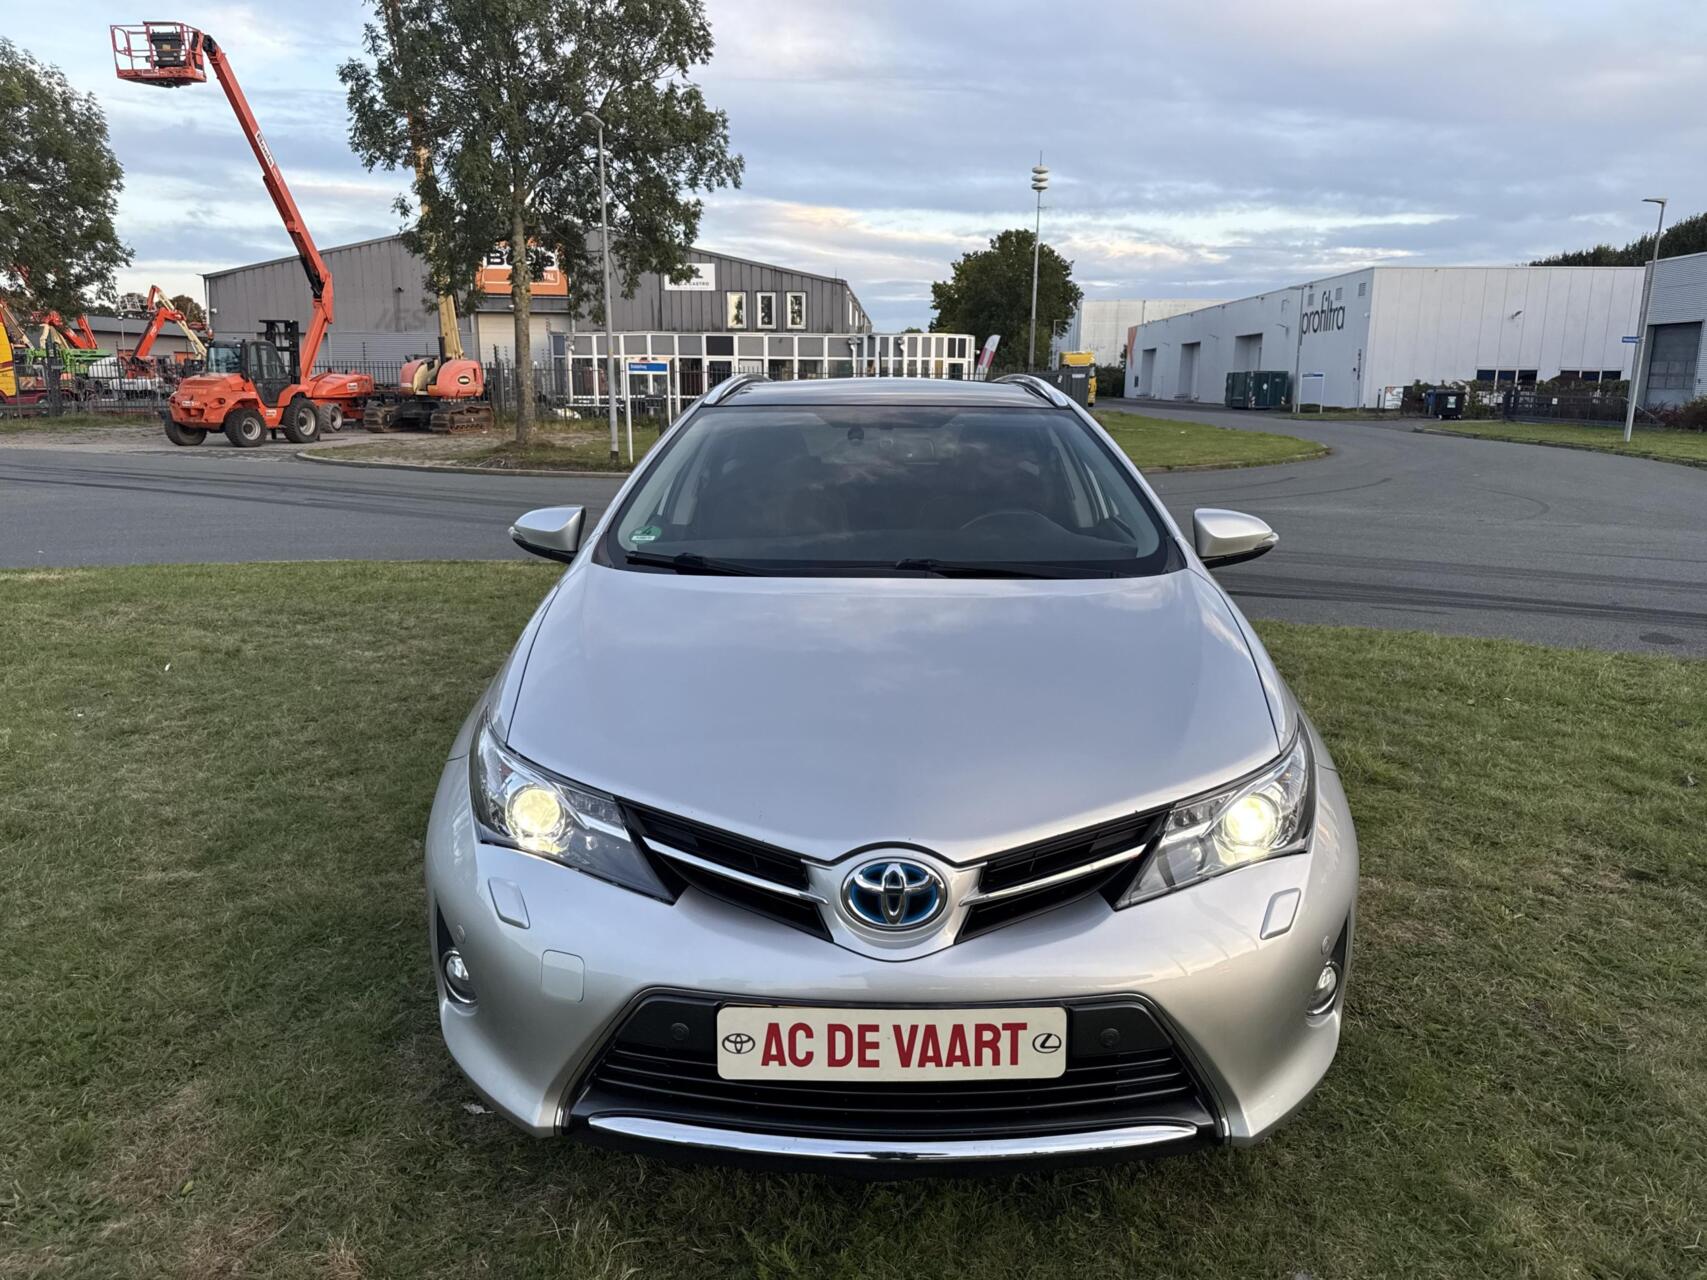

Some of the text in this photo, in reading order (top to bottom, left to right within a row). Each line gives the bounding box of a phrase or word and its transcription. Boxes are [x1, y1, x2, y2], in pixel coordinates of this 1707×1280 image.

[1300, 290, 1345, 346] profiltra
[761, 1022, 1028, 1068] AC DE VAART
